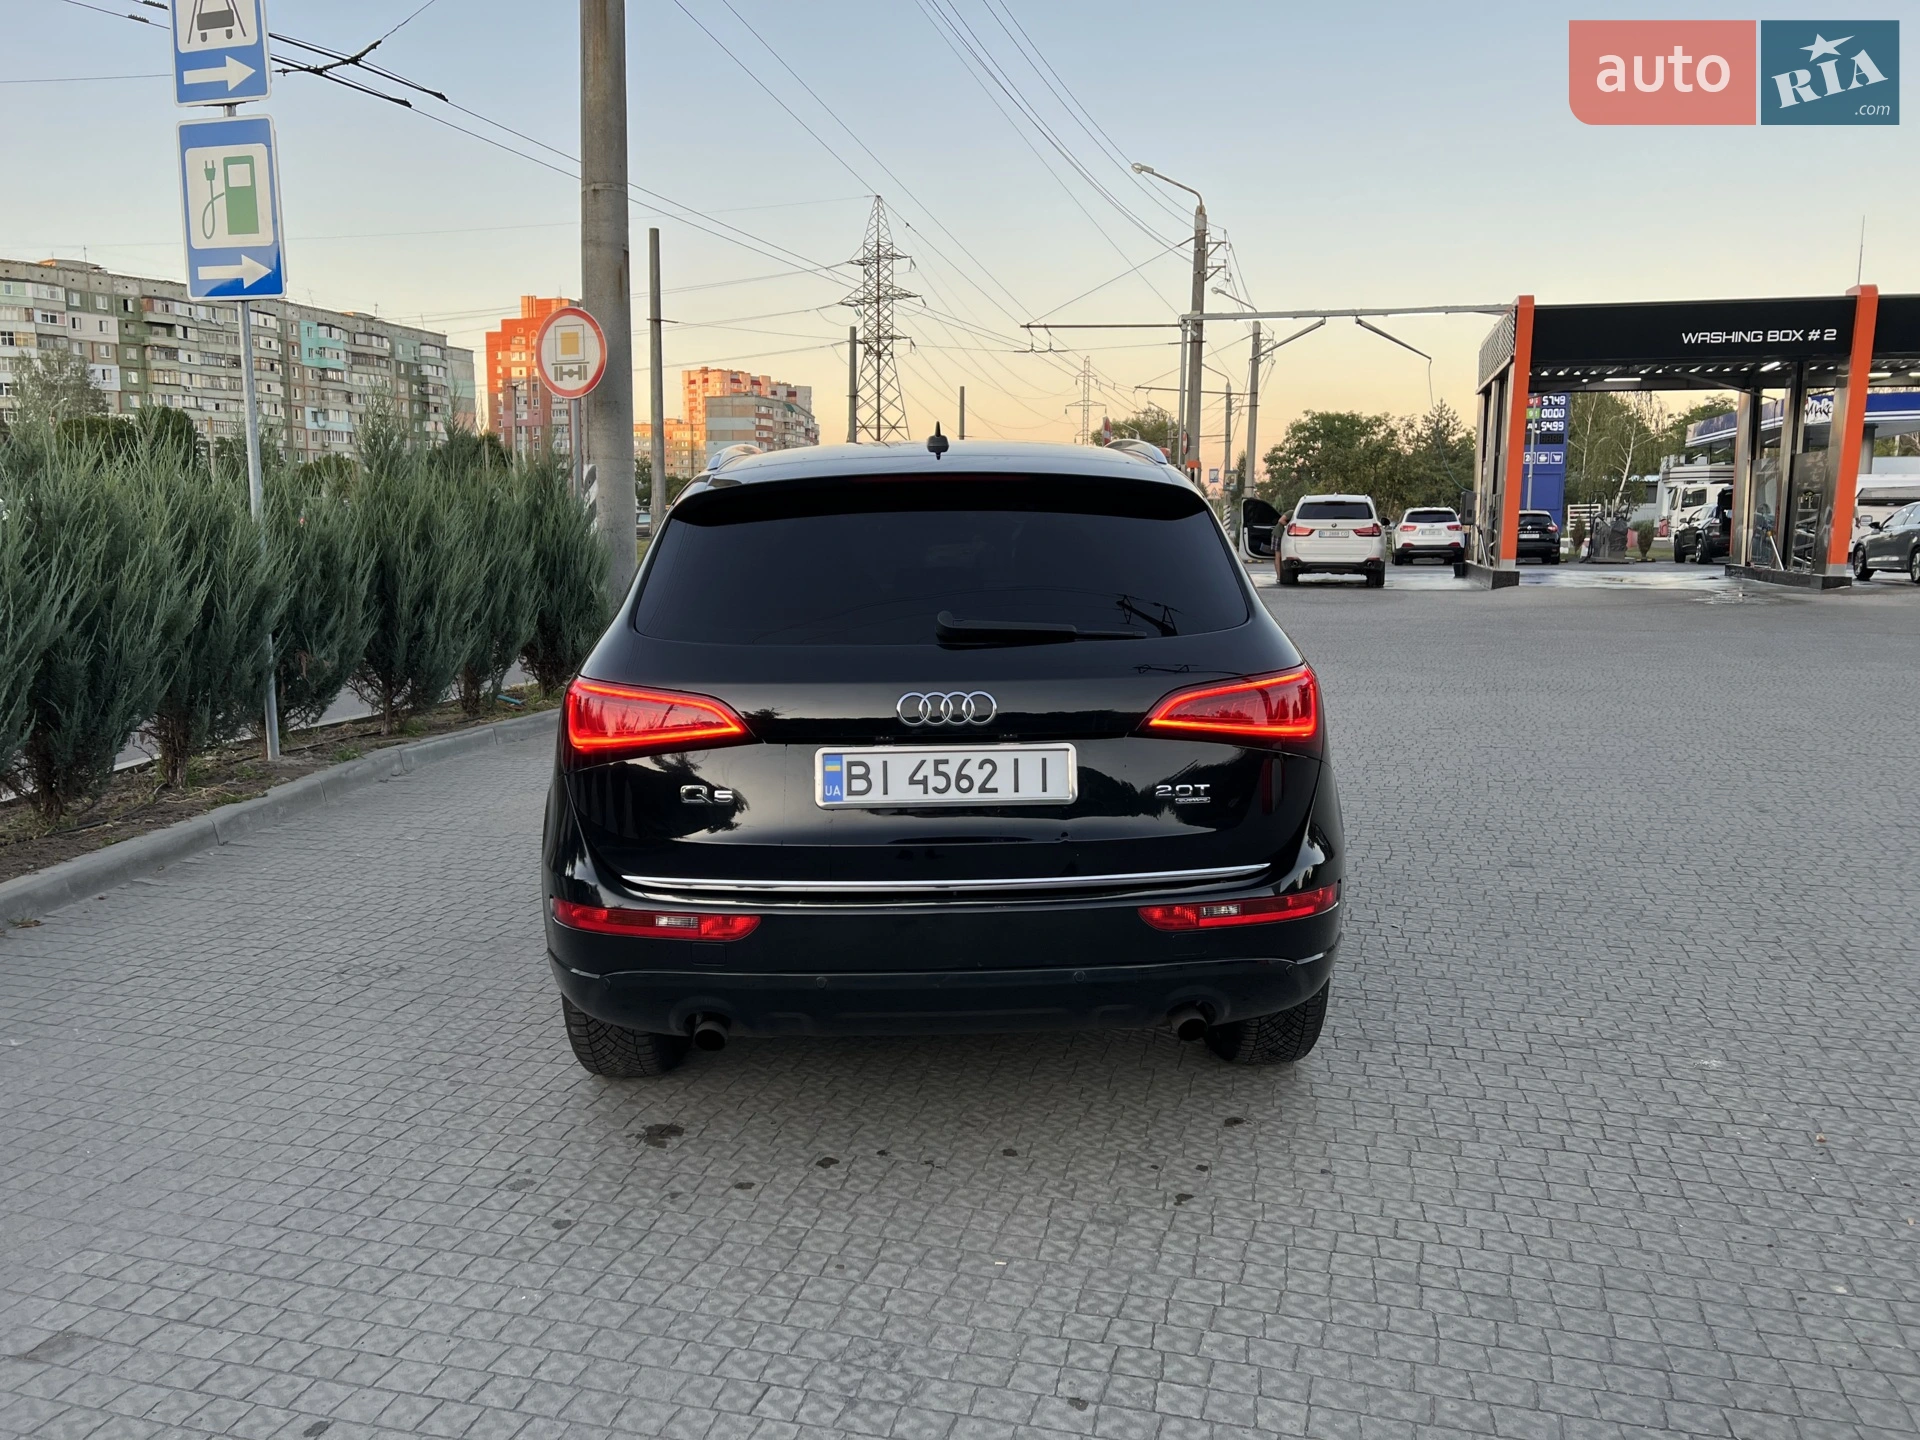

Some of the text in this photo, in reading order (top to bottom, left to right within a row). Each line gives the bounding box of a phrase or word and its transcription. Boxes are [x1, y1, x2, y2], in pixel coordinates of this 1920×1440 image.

[1681, 328, 1837, 344] WASHING BOX # 2
[846, 760, 888, 796] BI
[908, 758, 999, 795] 4562
[680, 784, 733, 804] Q5
[825, 785, 841, 797] UA
